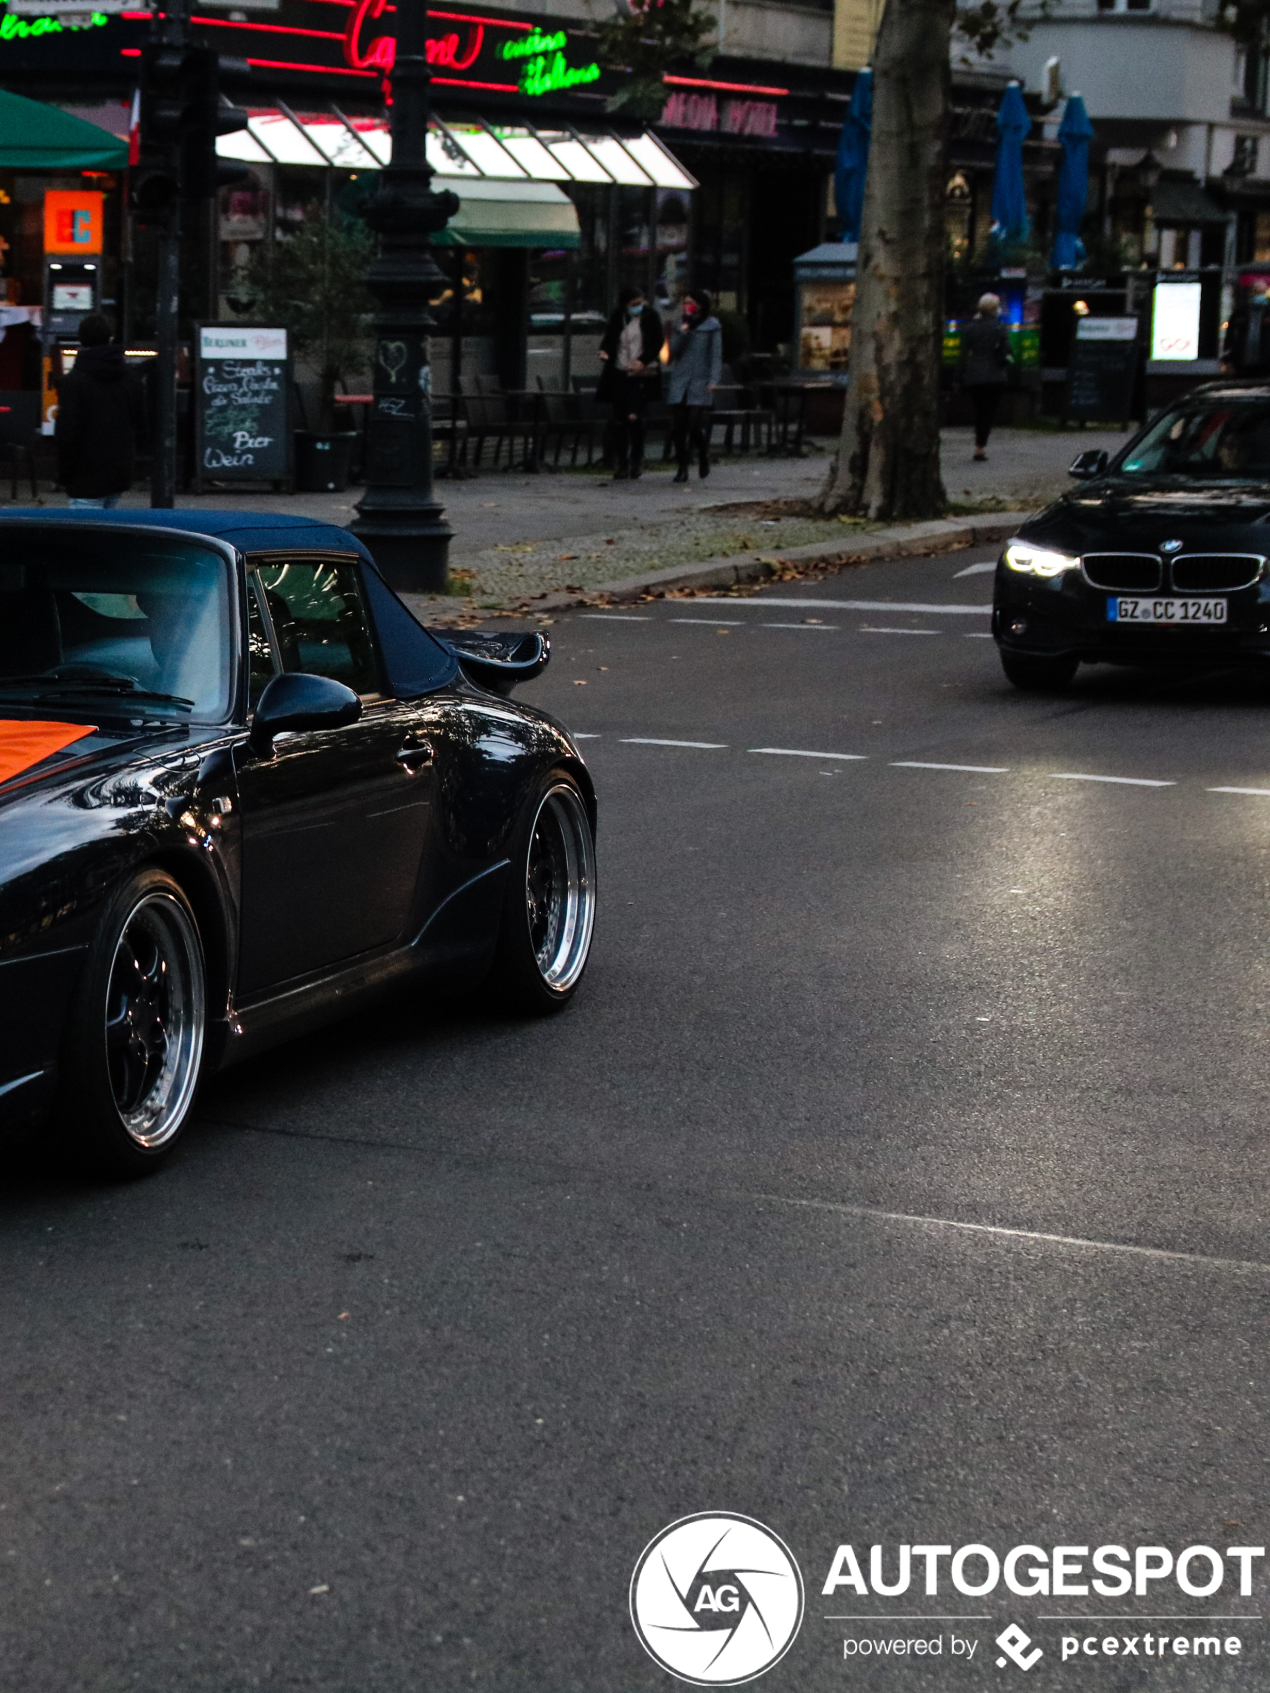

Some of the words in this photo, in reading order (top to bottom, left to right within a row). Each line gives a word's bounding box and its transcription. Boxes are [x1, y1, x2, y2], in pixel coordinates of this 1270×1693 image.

[203, 447, 255, 468] Wein
[1118, 601, 1139, 619] GZ
[1153, 602, 1175, 619] CC
[1179, 602, 1225, 620] 1240
